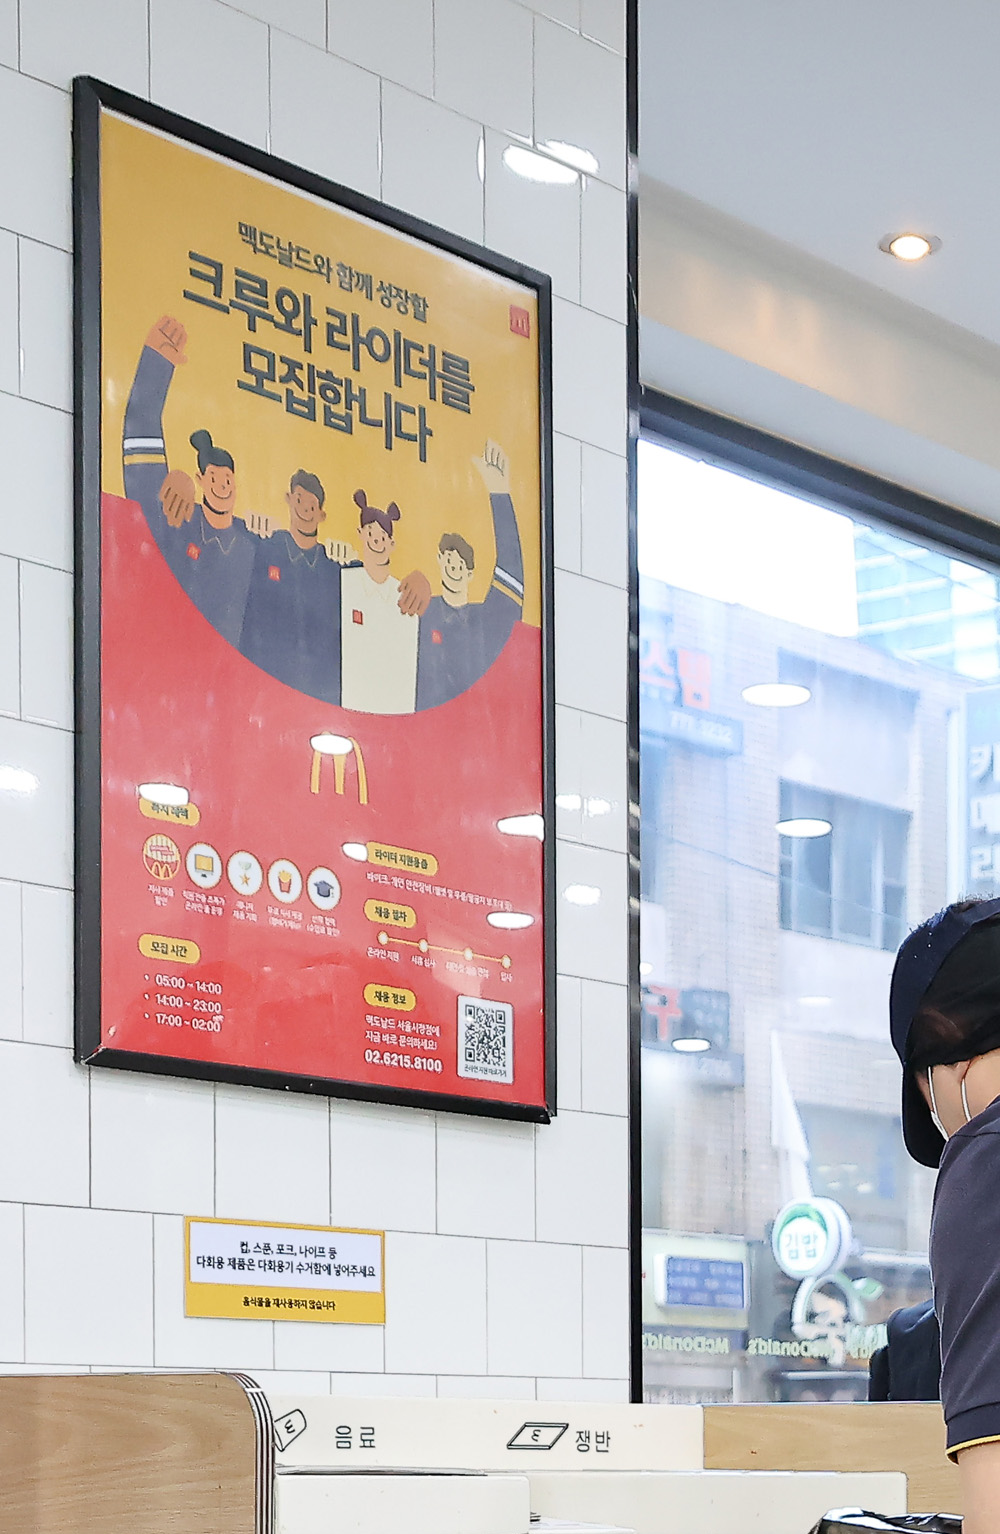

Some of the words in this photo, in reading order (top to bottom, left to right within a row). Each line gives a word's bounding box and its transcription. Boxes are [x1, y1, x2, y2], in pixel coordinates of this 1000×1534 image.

[238, 221, 333, 283] 맥도날드와
[336, 261, 373, 301] 함께
[377, 279, 429, 323] 성장할
[183, 250, 318, 353] 크루와
[325, 306, 475, 414] 라이더를
[237, 341, 433, 463] 모집합니다
[375, 849, 397, 864] 라이더
[374, 905, 391, 919] 채용
[151, 941, 168, 955] 모집
[171, 944, 188, 958] 시간
[155, 974, 185, 989] 05:00
[195, 980, 222, 995] 14:00
[155, 993, 184, 1008] 14:00
[193, 999, 222, 1014] 23:00
[374, 990, 390, 1002] 채용
[391, 993, 407, 1005] 정보
[155, 1013, 182, 1027] 17:00
[192, 1018, 221, 1032] 02:00
[365, 1014, 396, 1030] 맥도날드
[365, 1030, 381, 1044] 지금
[382, 1033, 398, 1045] 바로
[364, 1049, 443, 1074] 02.6215.8100
[240, 1241, 251, 1254] 컵,
[253, 1242, 274, 1256] 스푼,
[276, 1244, 297, 1256] 포크,
[299, 1245, 326, 1259] 나이프
[328, 1247, 337, 1260] 등
[196, 1256, 225, 1269] 다회용
[227, 1258, 256, 1271] 제품은
[258, 1261, 294, 1274] 다회용기
[296, 1263, 332, 1276] 수거함에
[333, 1264, 376, 1278] 넣어주세요
[335, 1425, 376, 1450] 음료
[575, 1429, 611, 1453] 쟁반
